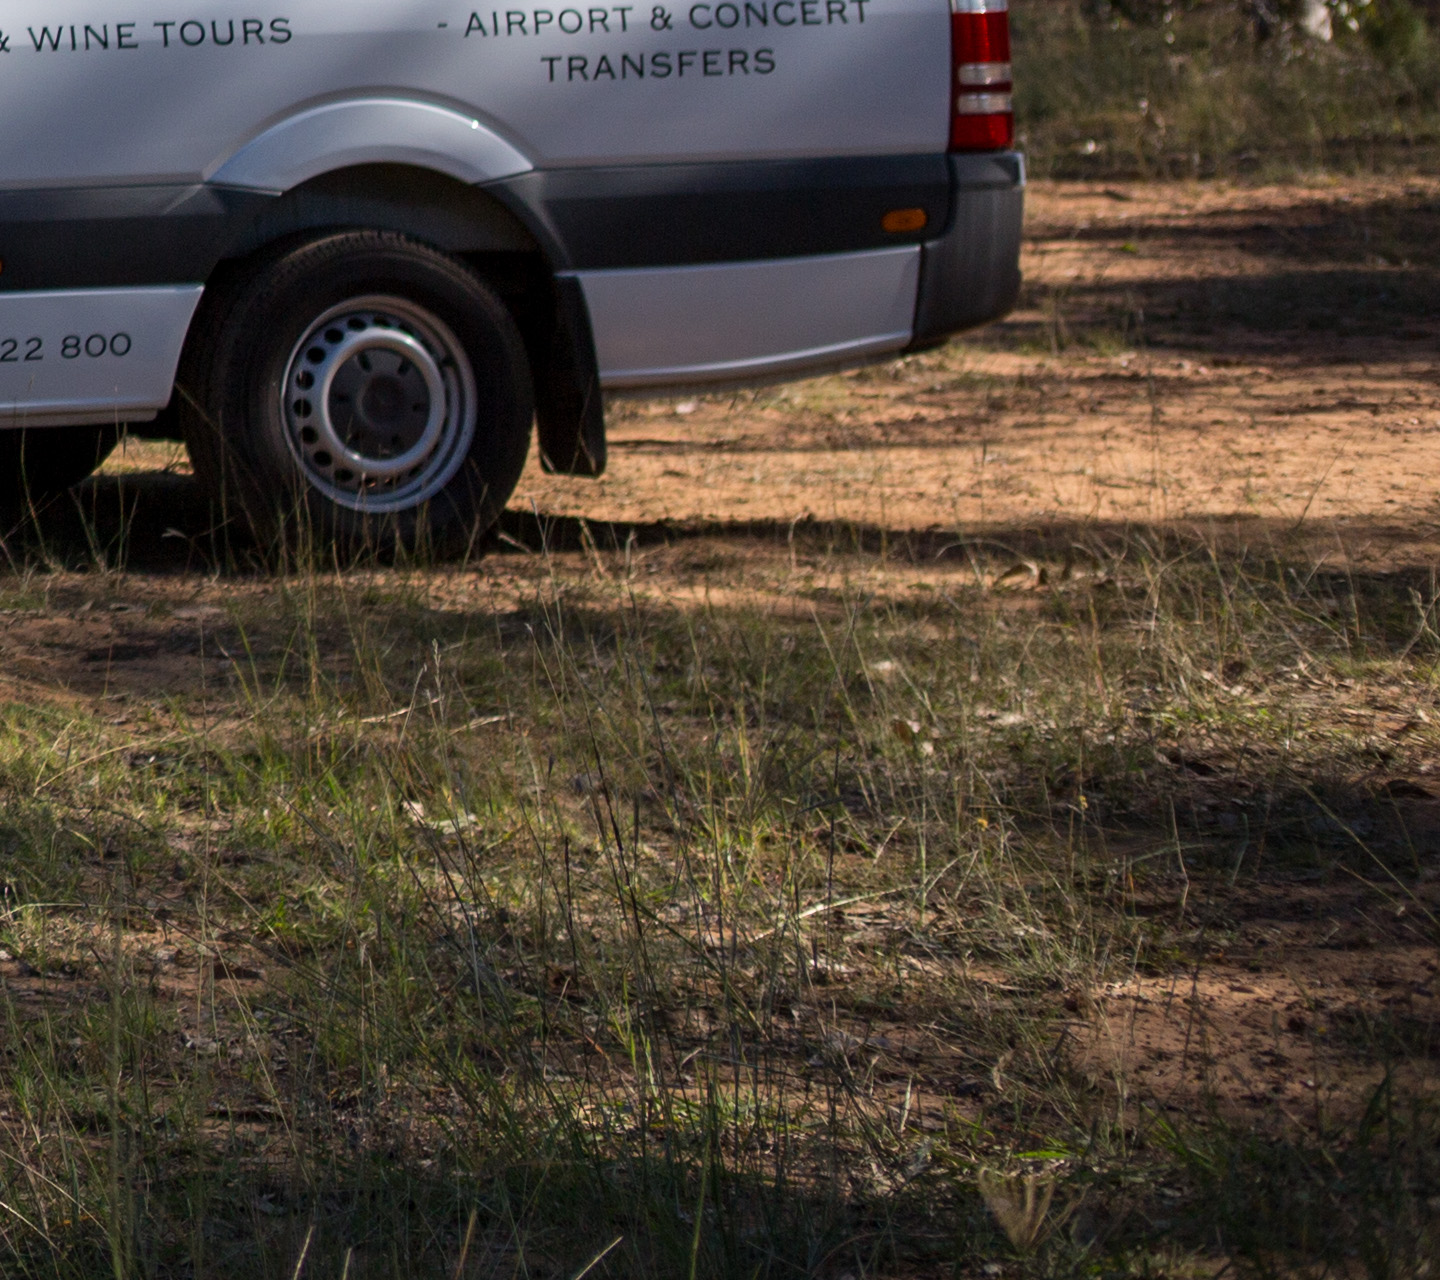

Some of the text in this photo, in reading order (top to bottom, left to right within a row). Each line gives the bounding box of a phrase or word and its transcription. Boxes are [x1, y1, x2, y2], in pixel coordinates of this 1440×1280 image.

[27, 23, 140, 52] WINE
[153, 18, 293, 49] TOURS
[464, 6, 634, 38] AIRPORT
[651, 6, 673, 31] &
[541, 49, 777, 82] TRANSFERS
[60, 332, 132, 359] 800
